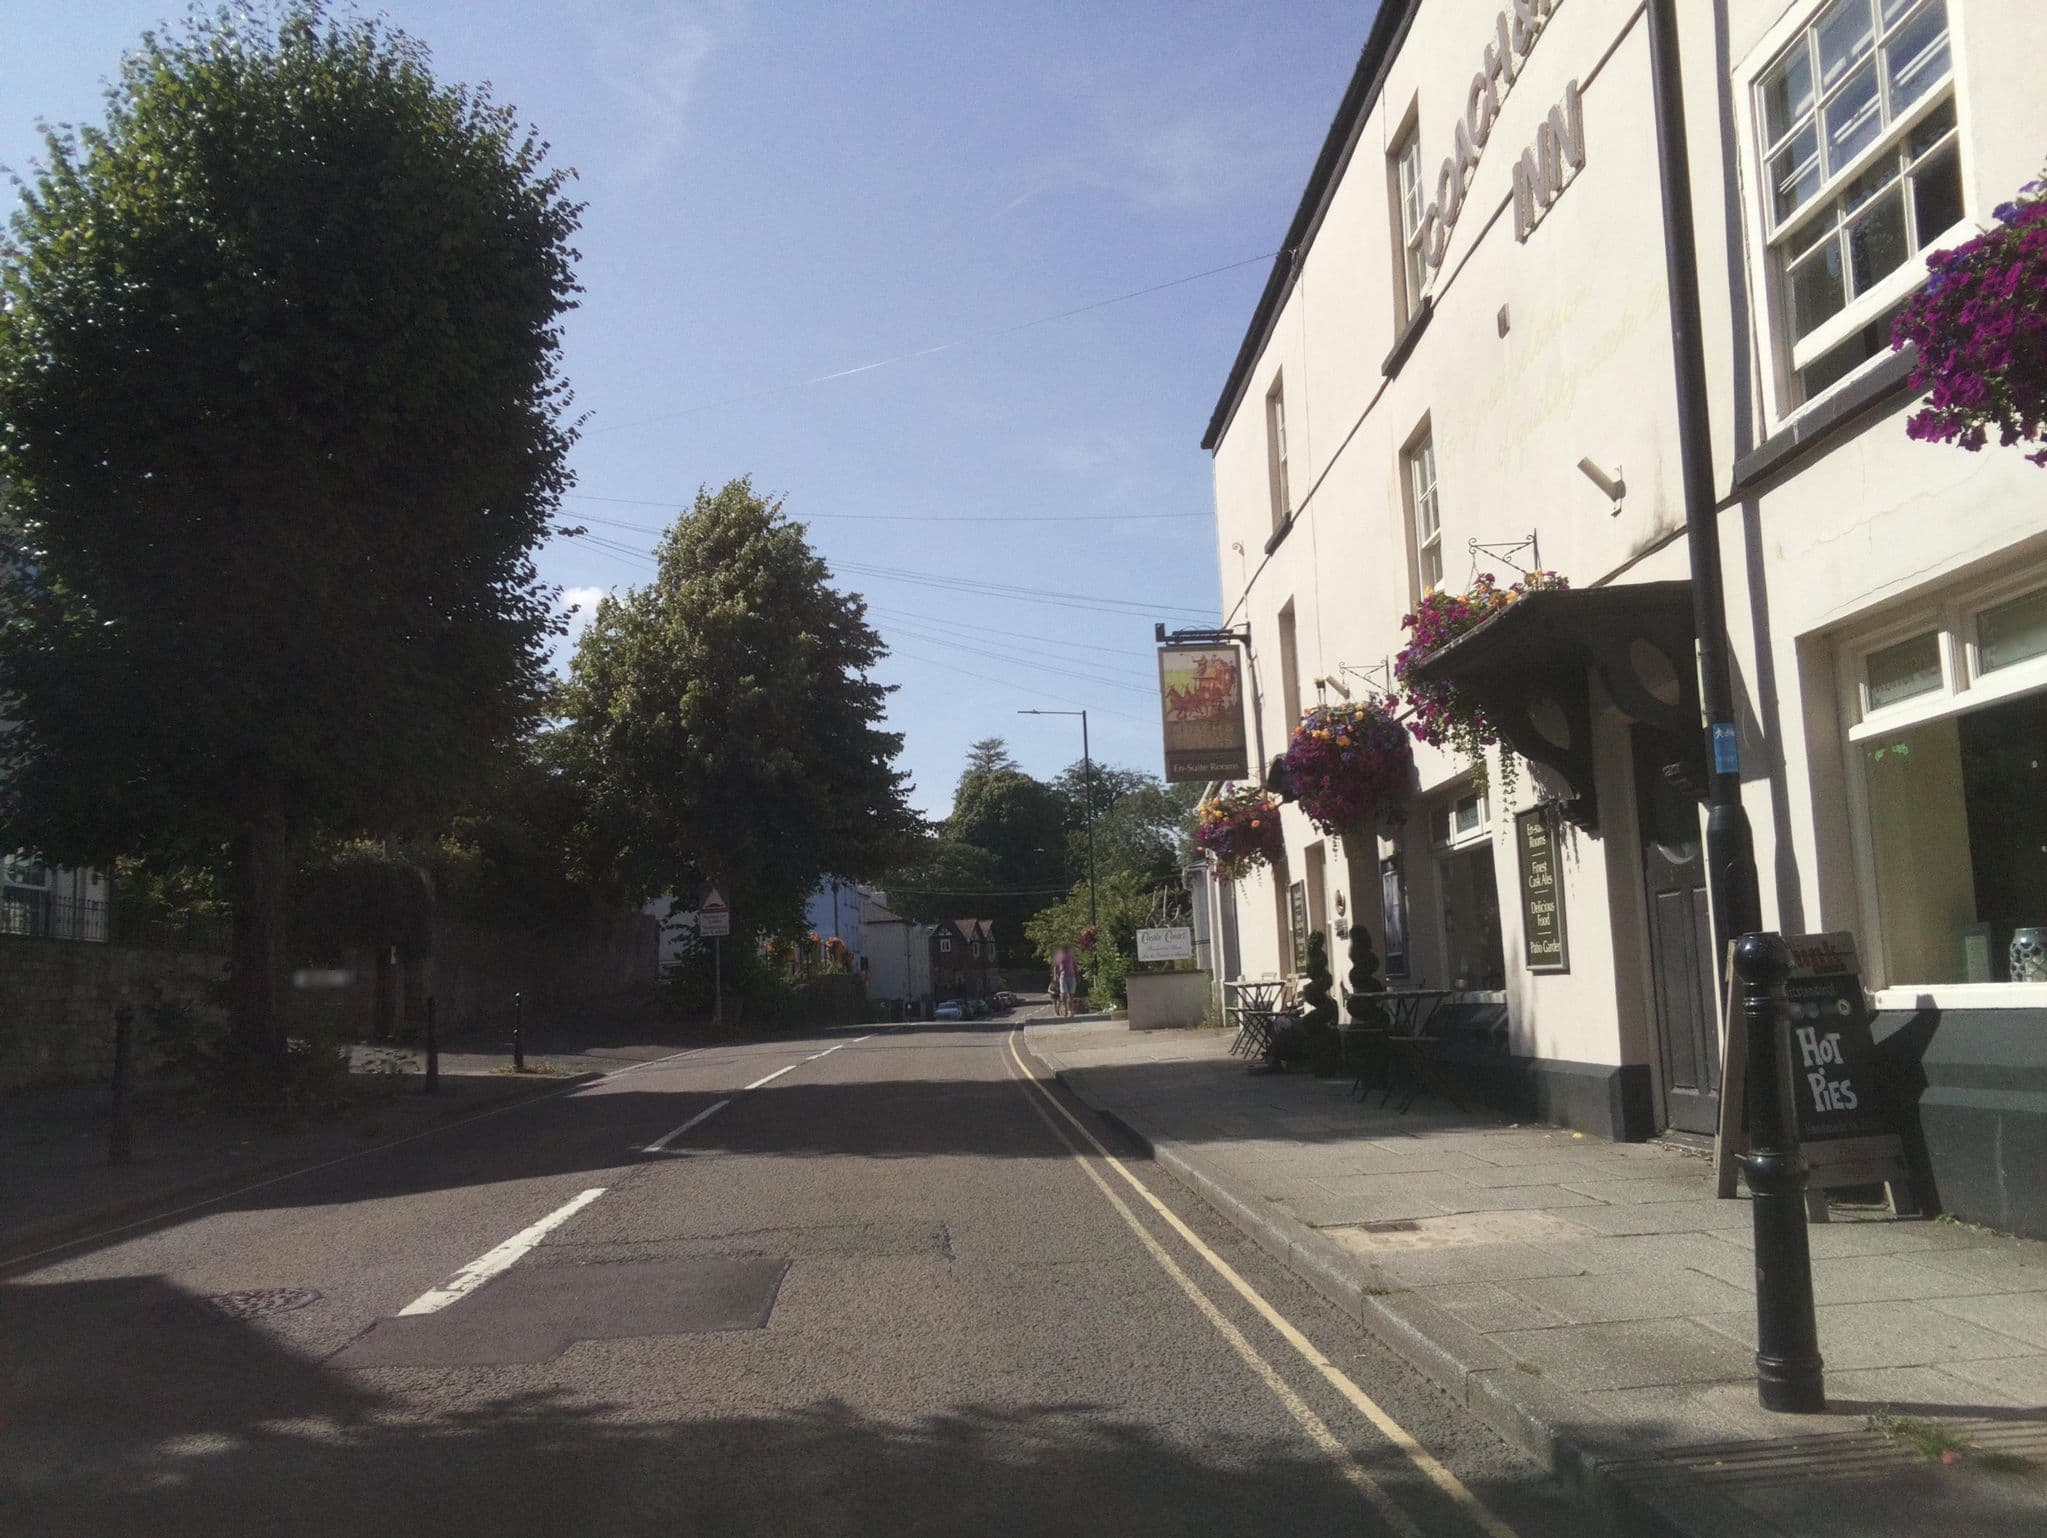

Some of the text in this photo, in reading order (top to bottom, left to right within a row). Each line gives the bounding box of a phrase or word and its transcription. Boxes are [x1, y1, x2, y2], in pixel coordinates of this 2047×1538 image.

[1423, 10, 1515, 268] COACH
[1512, 79, 1586, 245] INN
[1531, 860, 1548, 875] Finest
[1530, 899, 1556, 914] Delicious
[1537, 912, 1551, 927] Food
